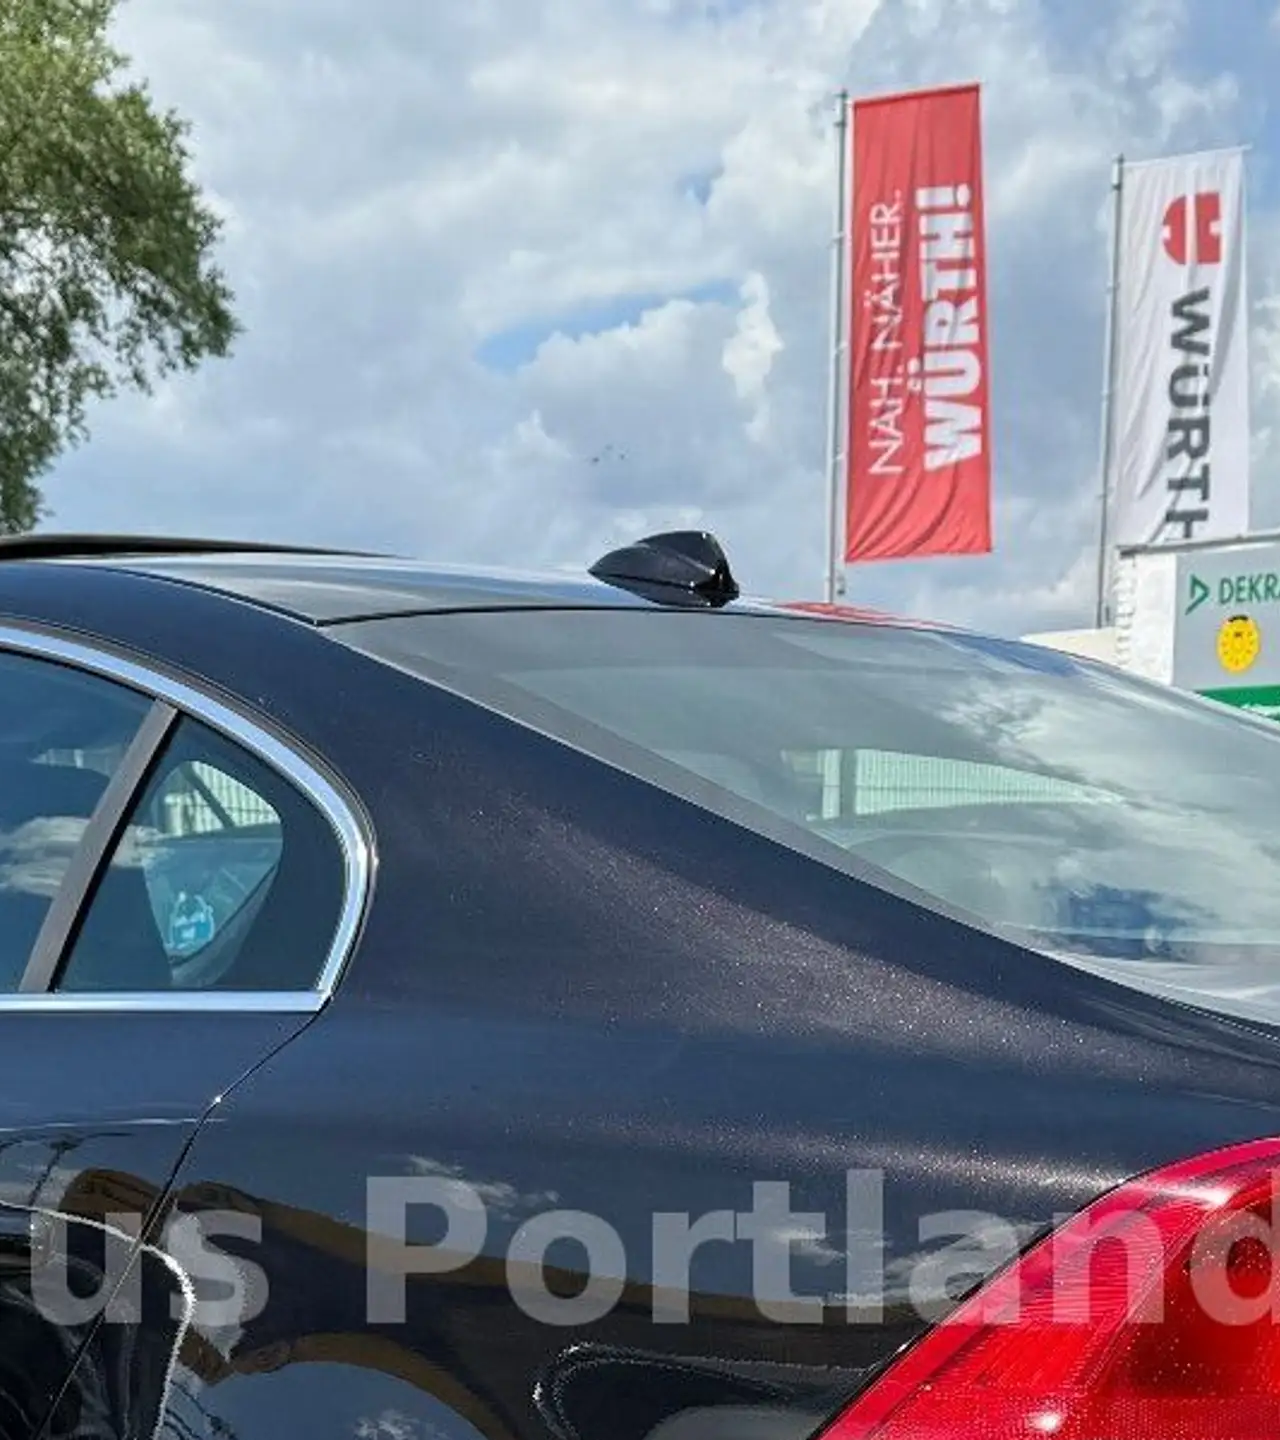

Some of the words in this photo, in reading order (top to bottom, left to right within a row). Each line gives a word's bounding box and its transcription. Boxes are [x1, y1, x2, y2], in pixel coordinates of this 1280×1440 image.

[863, 188, 903, 351] NÄHER.
[907, 183, 982, 472] WÜRTH!
[868, 363, 903, 474] NAH.
